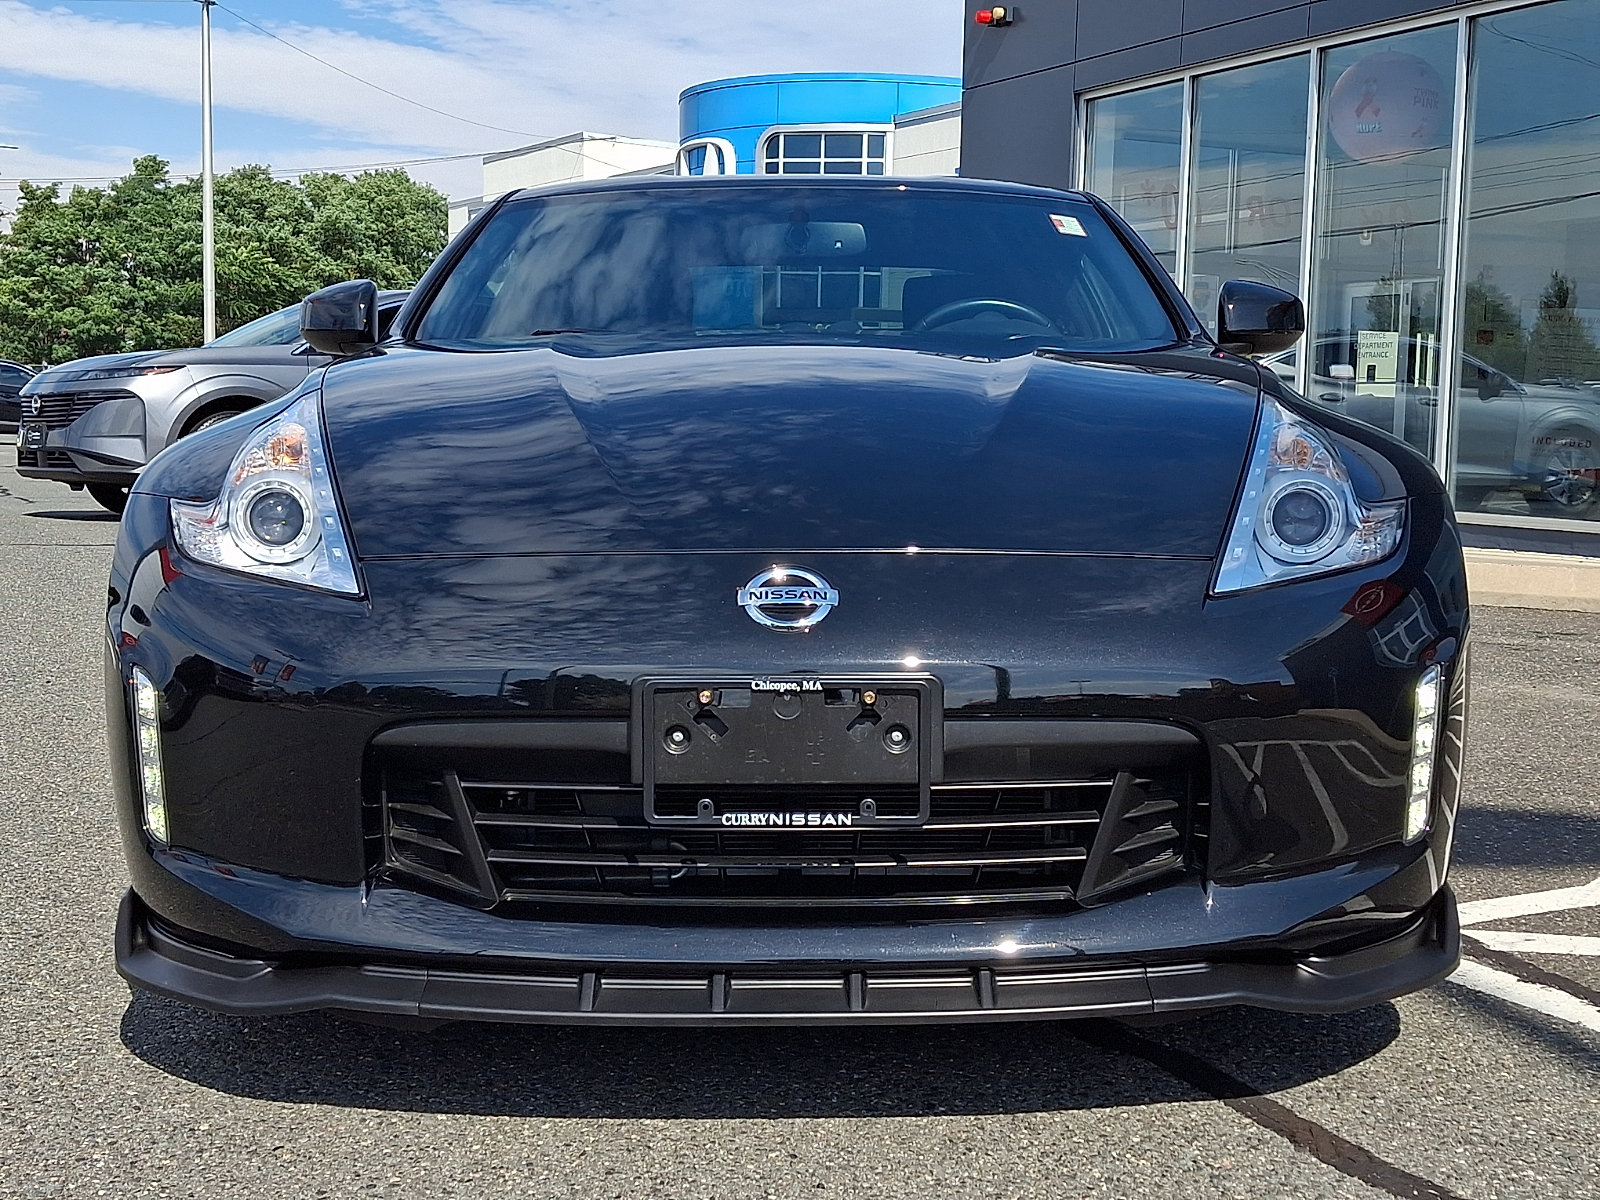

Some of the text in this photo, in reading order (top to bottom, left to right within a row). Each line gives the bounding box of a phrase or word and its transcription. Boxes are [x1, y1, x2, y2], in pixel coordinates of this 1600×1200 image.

[1413, 95, 1440, 110] PINK
[1361, 332, 1387, 340] SERVICE
[1353, 341, 1393, 350] DEPARTMENT
[749, 589, 828, 601] NISSAN
[751, 680, 823, 692] Chicopee, MA
